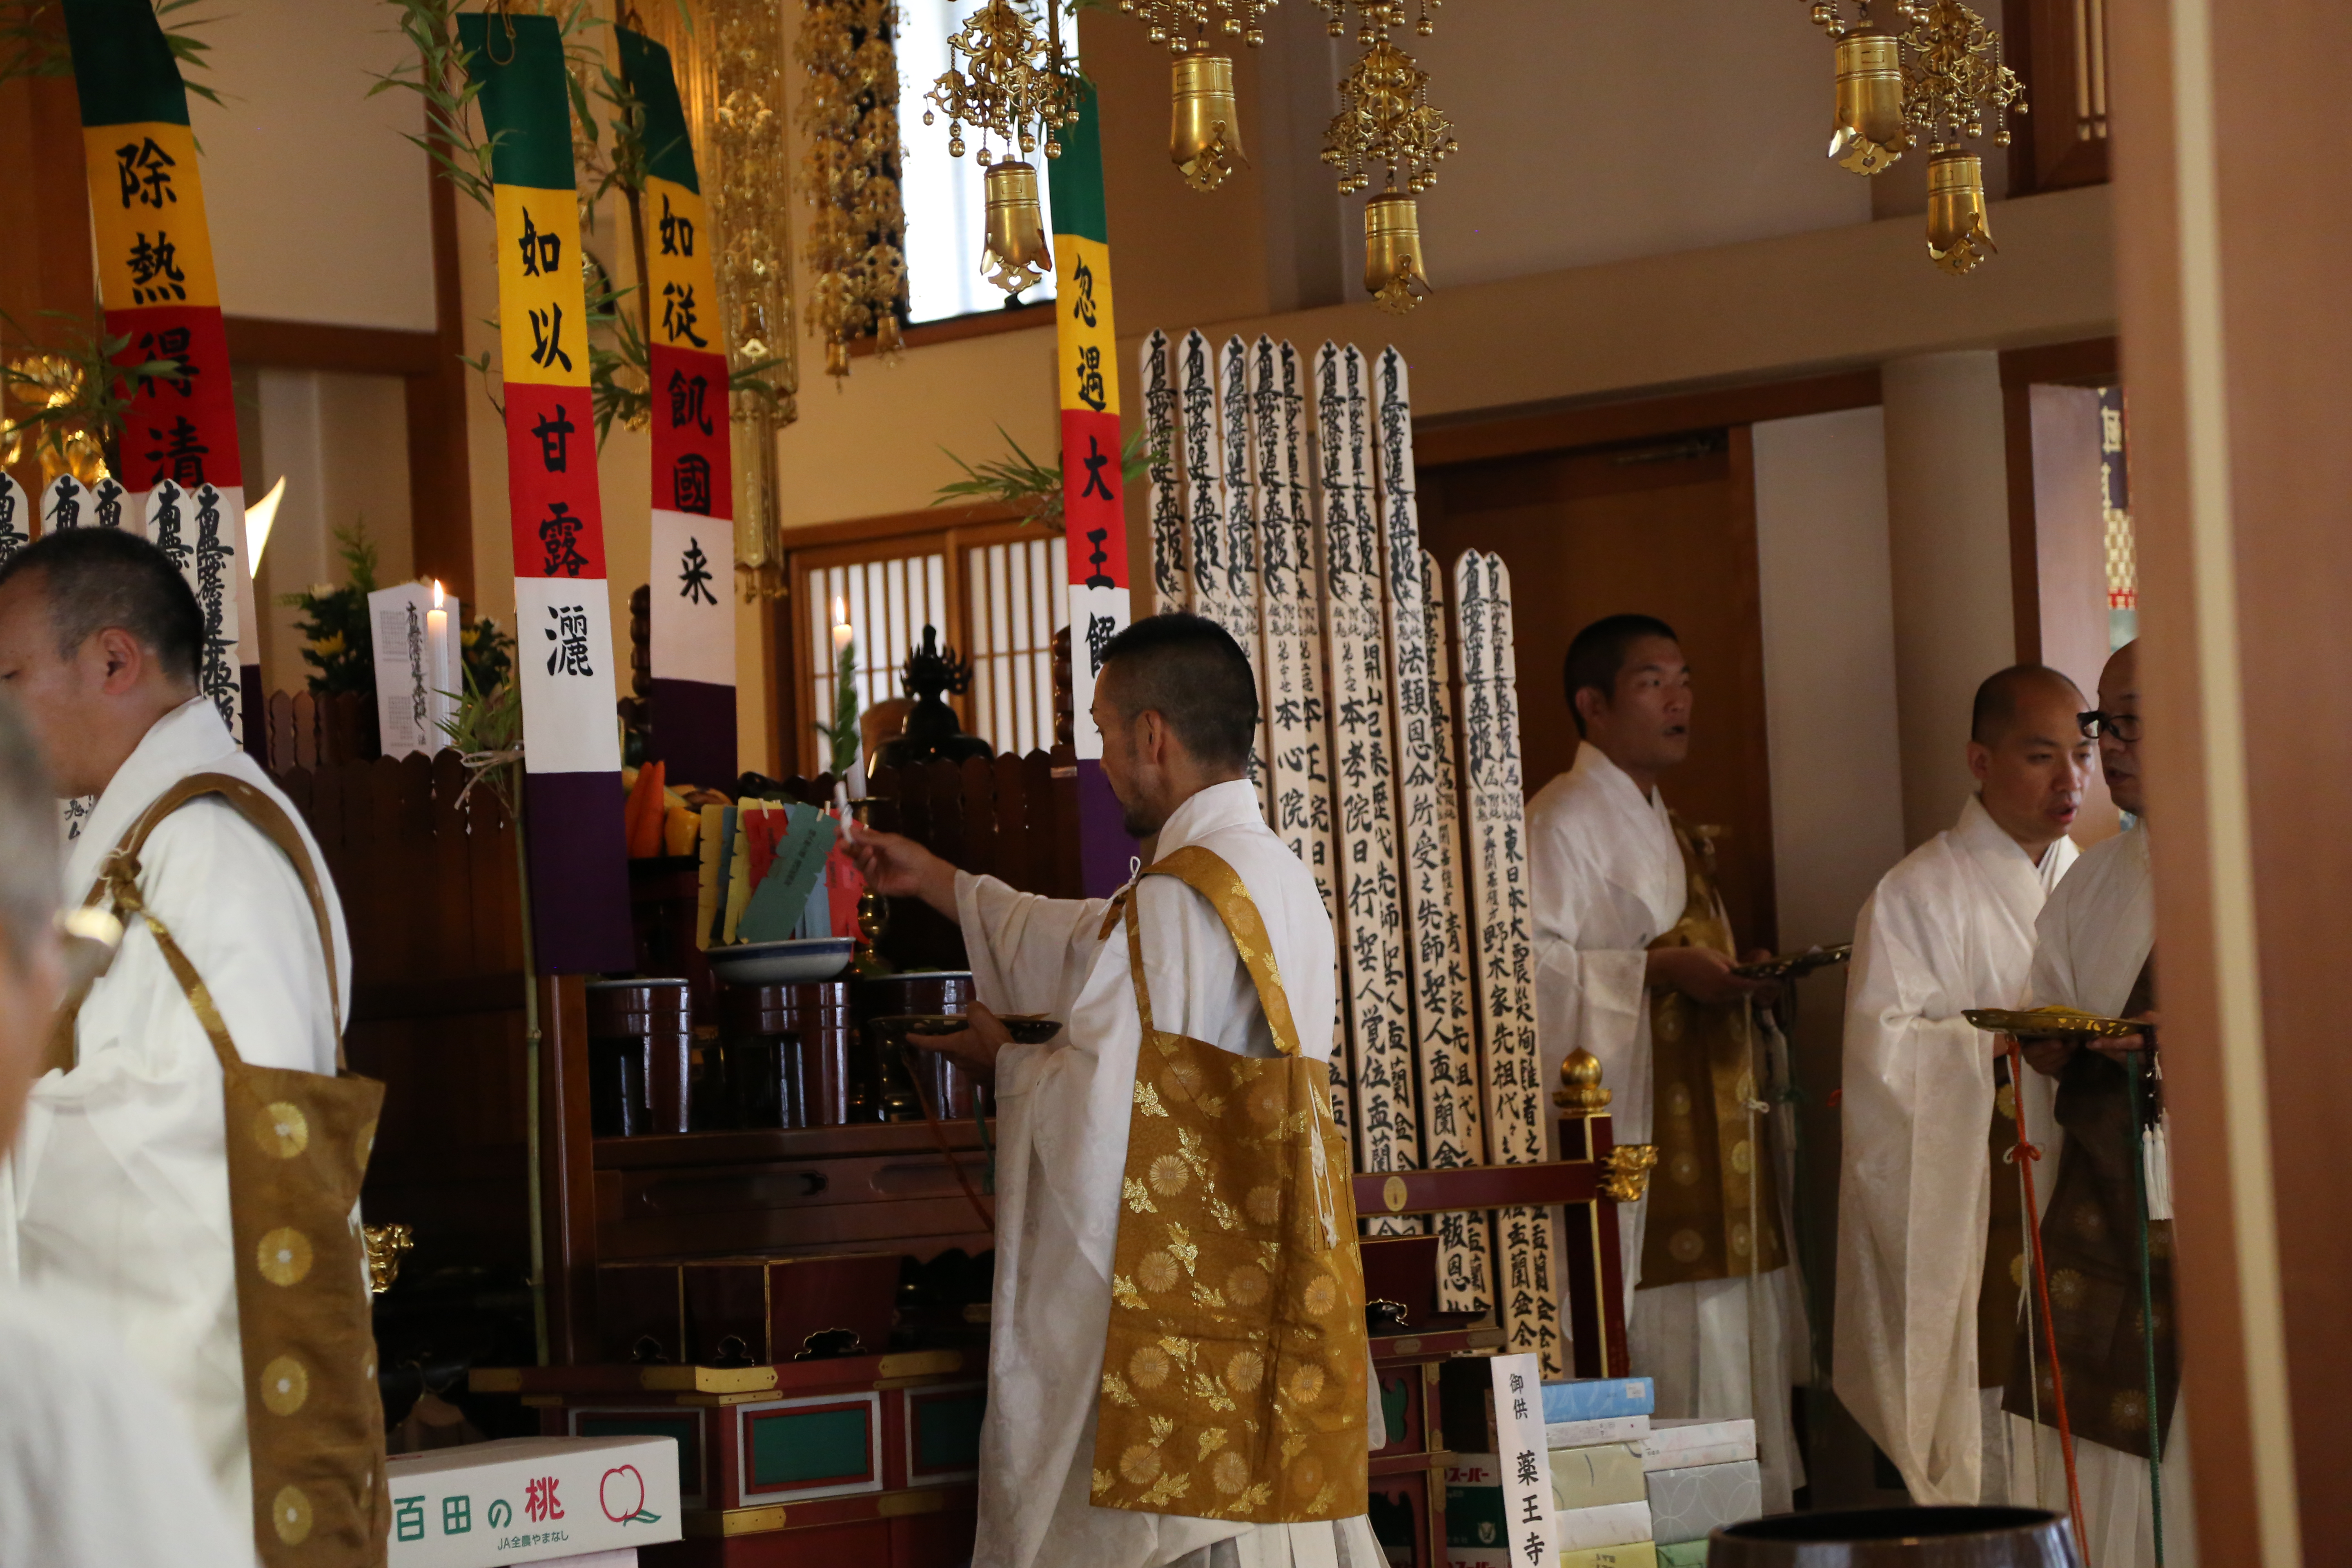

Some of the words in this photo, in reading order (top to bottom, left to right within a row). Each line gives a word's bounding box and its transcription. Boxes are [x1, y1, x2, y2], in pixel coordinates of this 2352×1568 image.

[1508, 1372, 1528, 1420] 御供
[1444, 1468, 1489, 1482] スーパー
[1516, 1450, 1545, 1567] 薬王寺
[497, 1530, 569, 1550] JA全農やまなし
